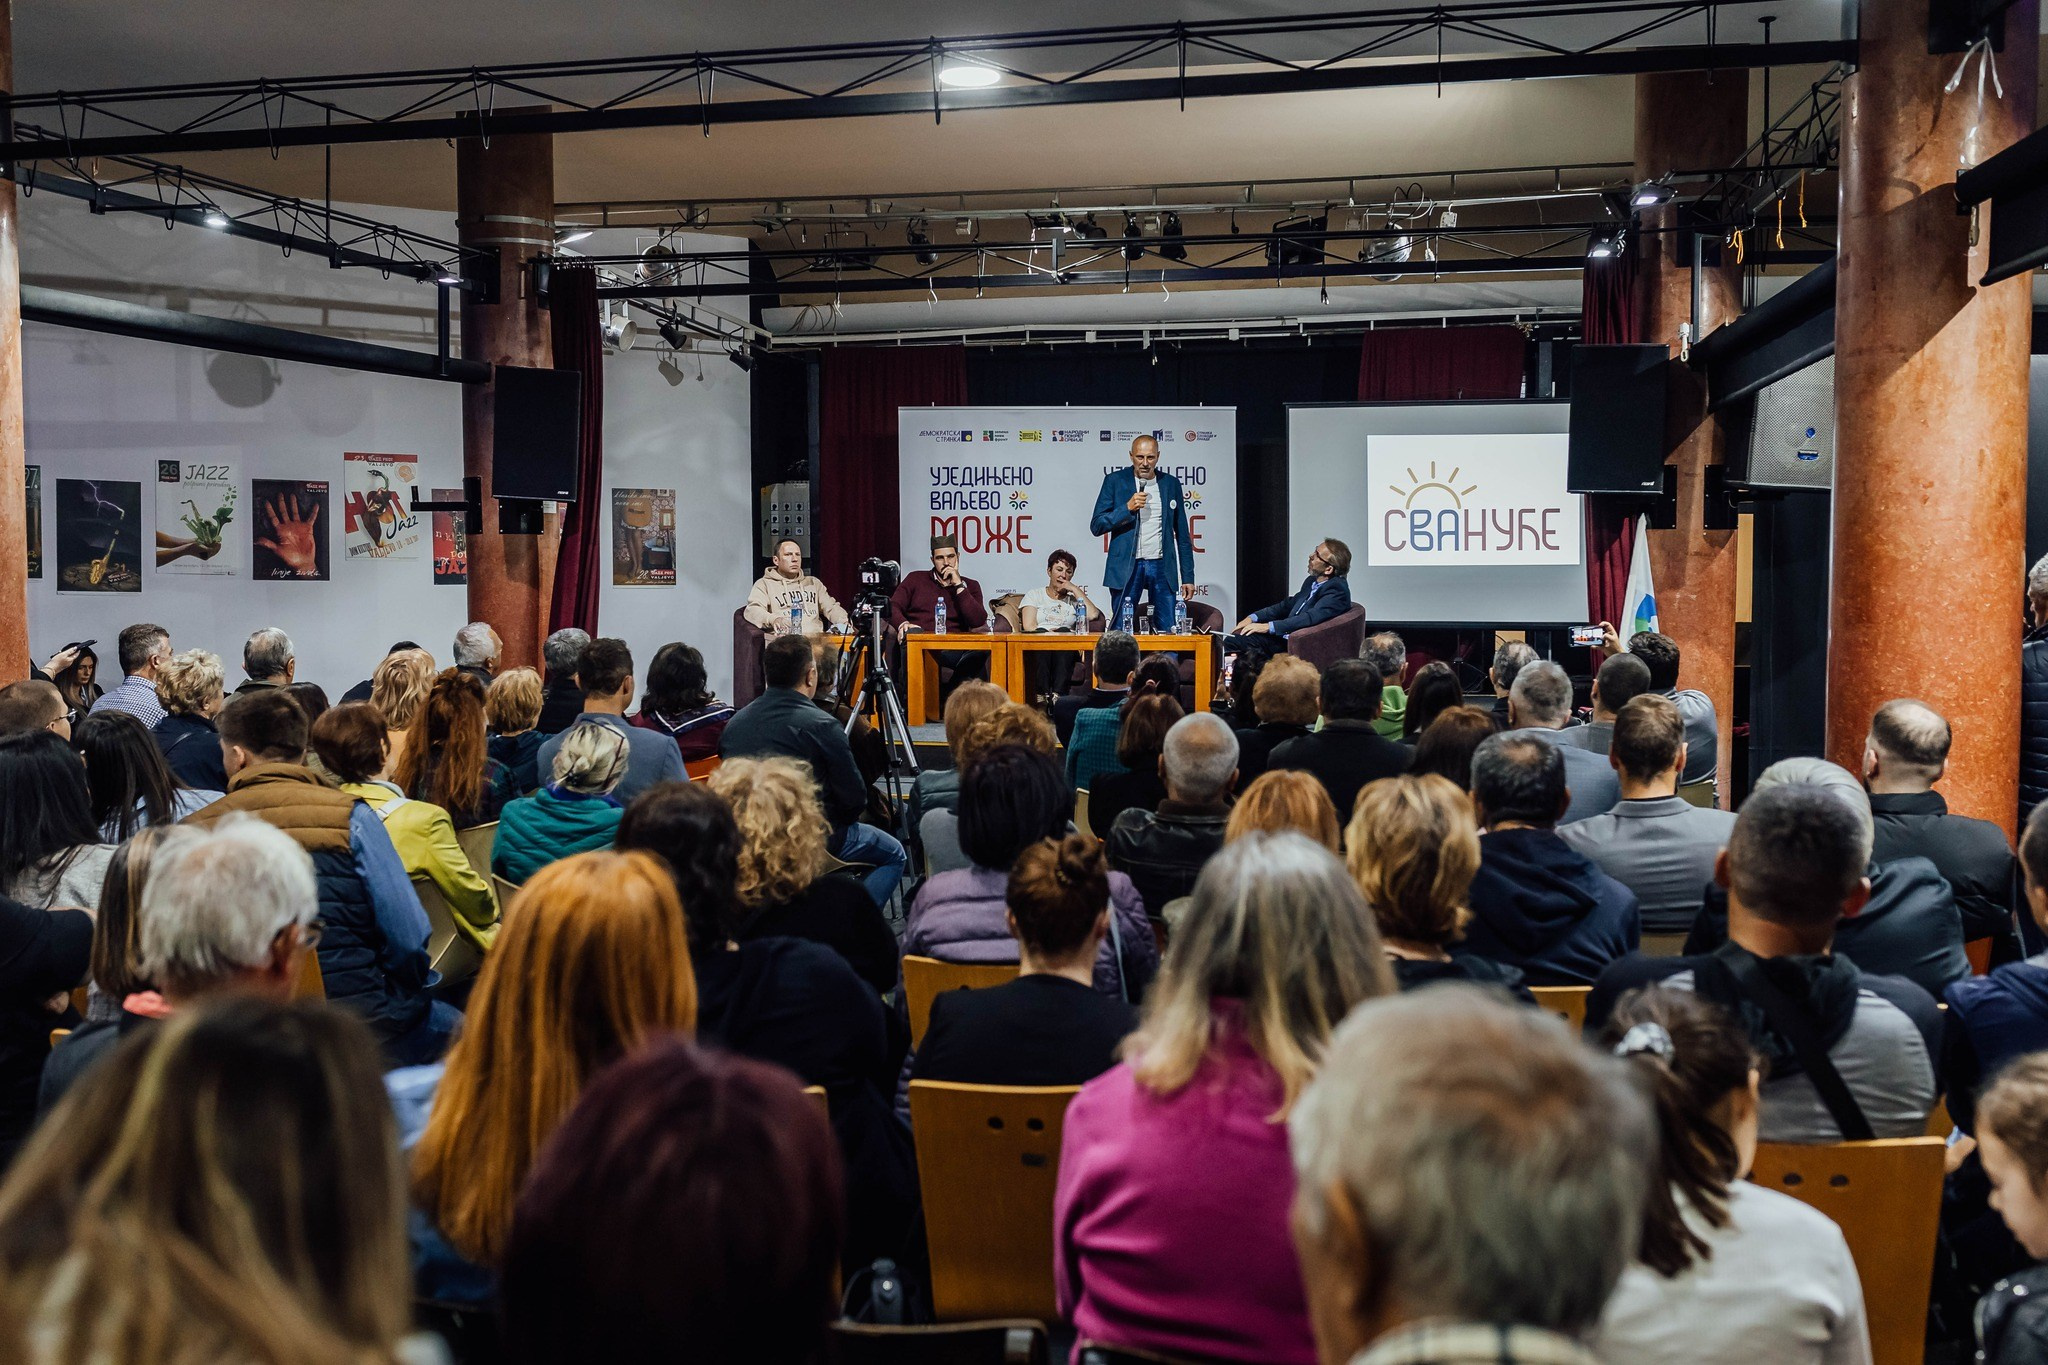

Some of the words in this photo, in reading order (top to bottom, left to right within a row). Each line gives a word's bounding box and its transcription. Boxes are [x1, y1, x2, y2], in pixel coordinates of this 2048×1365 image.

[160, 463, 178, 475] 26
[185, 464, 230, 480] JAZZ
[930, 466, 1033, 487] УЈЕДИЊЕНО
[930, 491, 1000, 510] ВАЉЕВО
[931, 516, 1033, 553] МОЖЕ
[1384, 508, 1560, 551] СВАНУЋЕ
[435, 556, 467, 575] JAZ
